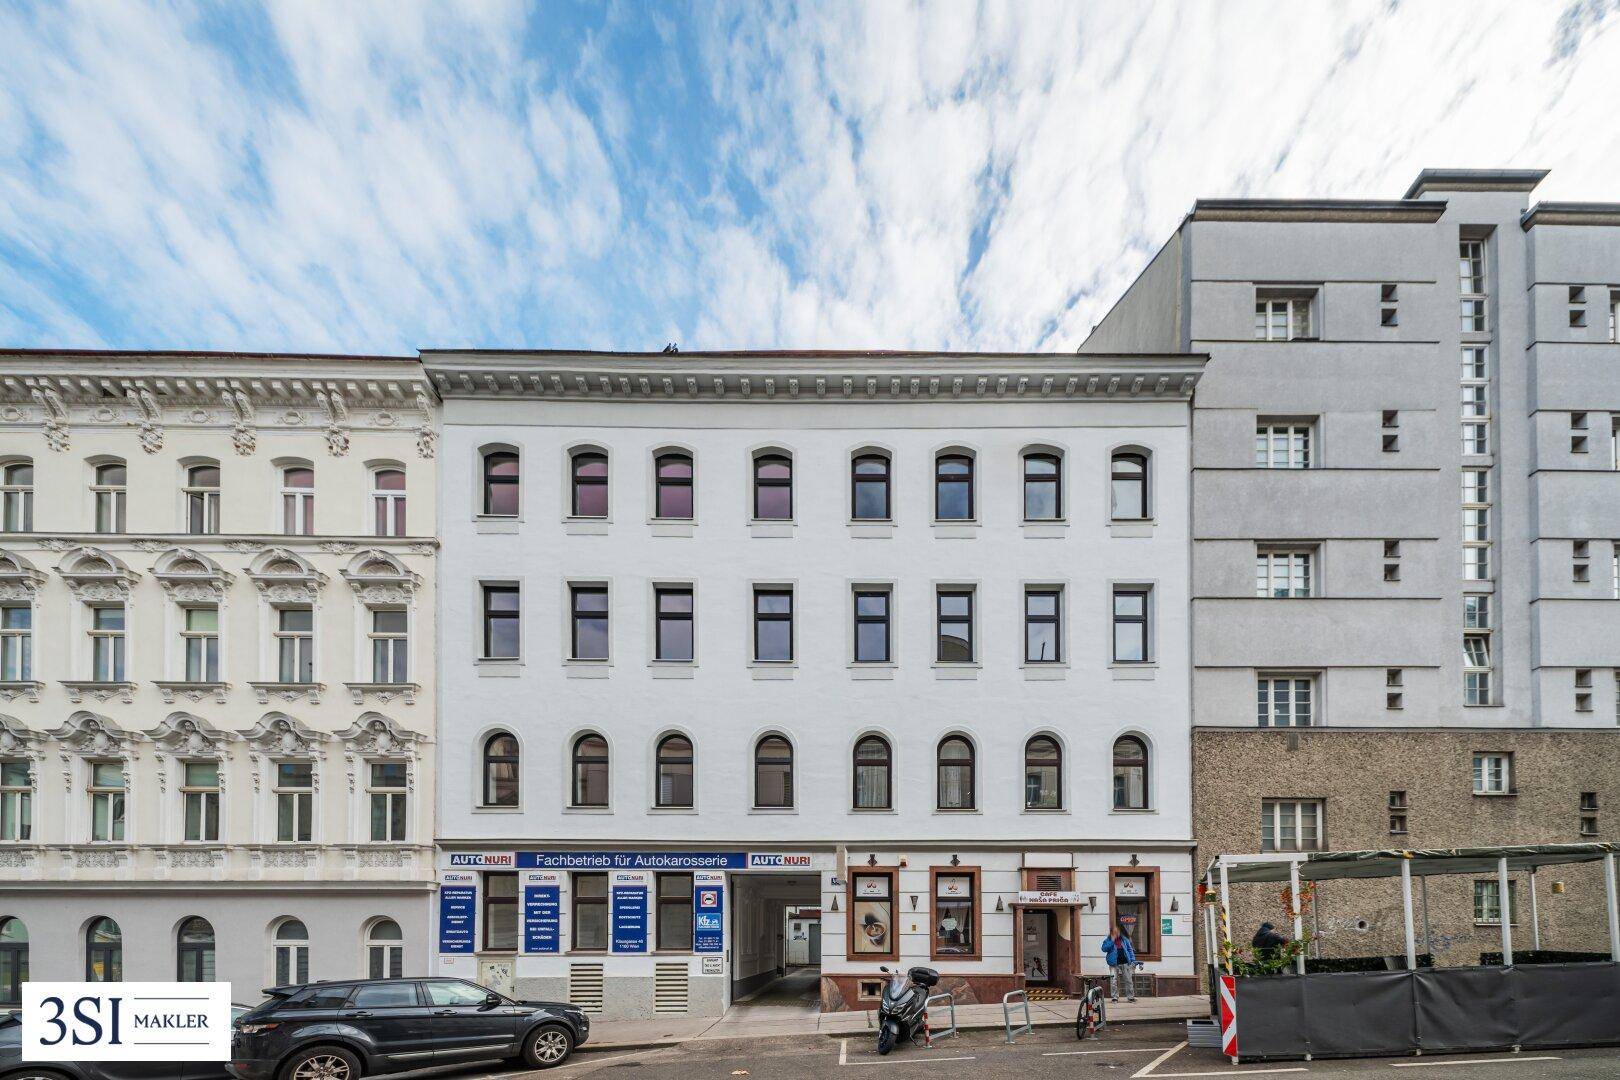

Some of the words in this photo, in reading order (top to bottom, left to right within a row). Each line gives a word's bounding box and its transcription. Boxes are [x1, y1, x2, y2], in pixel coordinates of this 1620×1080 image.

[536, 854, 611, 866] Fachbetrieb
[614, 854, 634, 866] für
[636, 854, 728, 866] Autokarosserie
